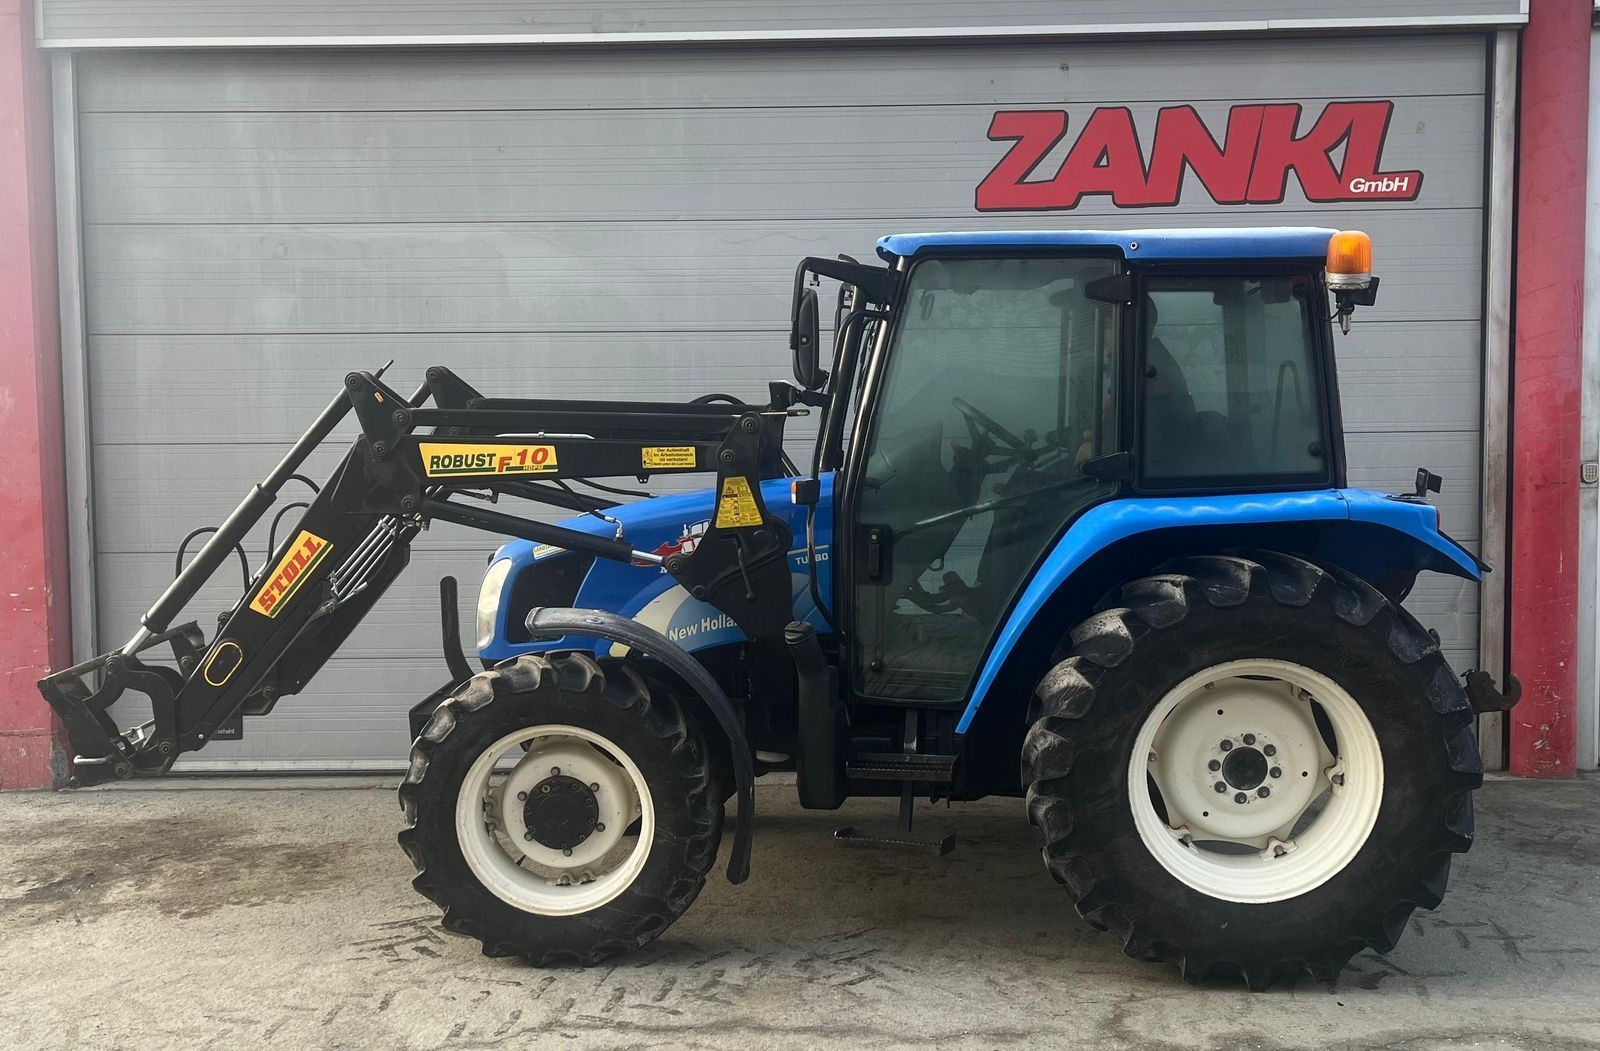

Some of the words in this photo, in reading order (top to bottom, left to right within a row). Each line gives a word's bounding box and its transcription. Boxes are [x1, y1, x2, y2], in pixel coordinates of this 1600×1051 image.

[975, 101, 1424, 211] ZANKL
[1349, 176, 1409, 193] GmbH
[430, 453, 496, 469] ROBUST
[795, 552, 829, 565] TUBO
[258, 537, 322, 612] STOLL
[668, 623, 698, 641] New
[701, 613, 738, 633] Holla
